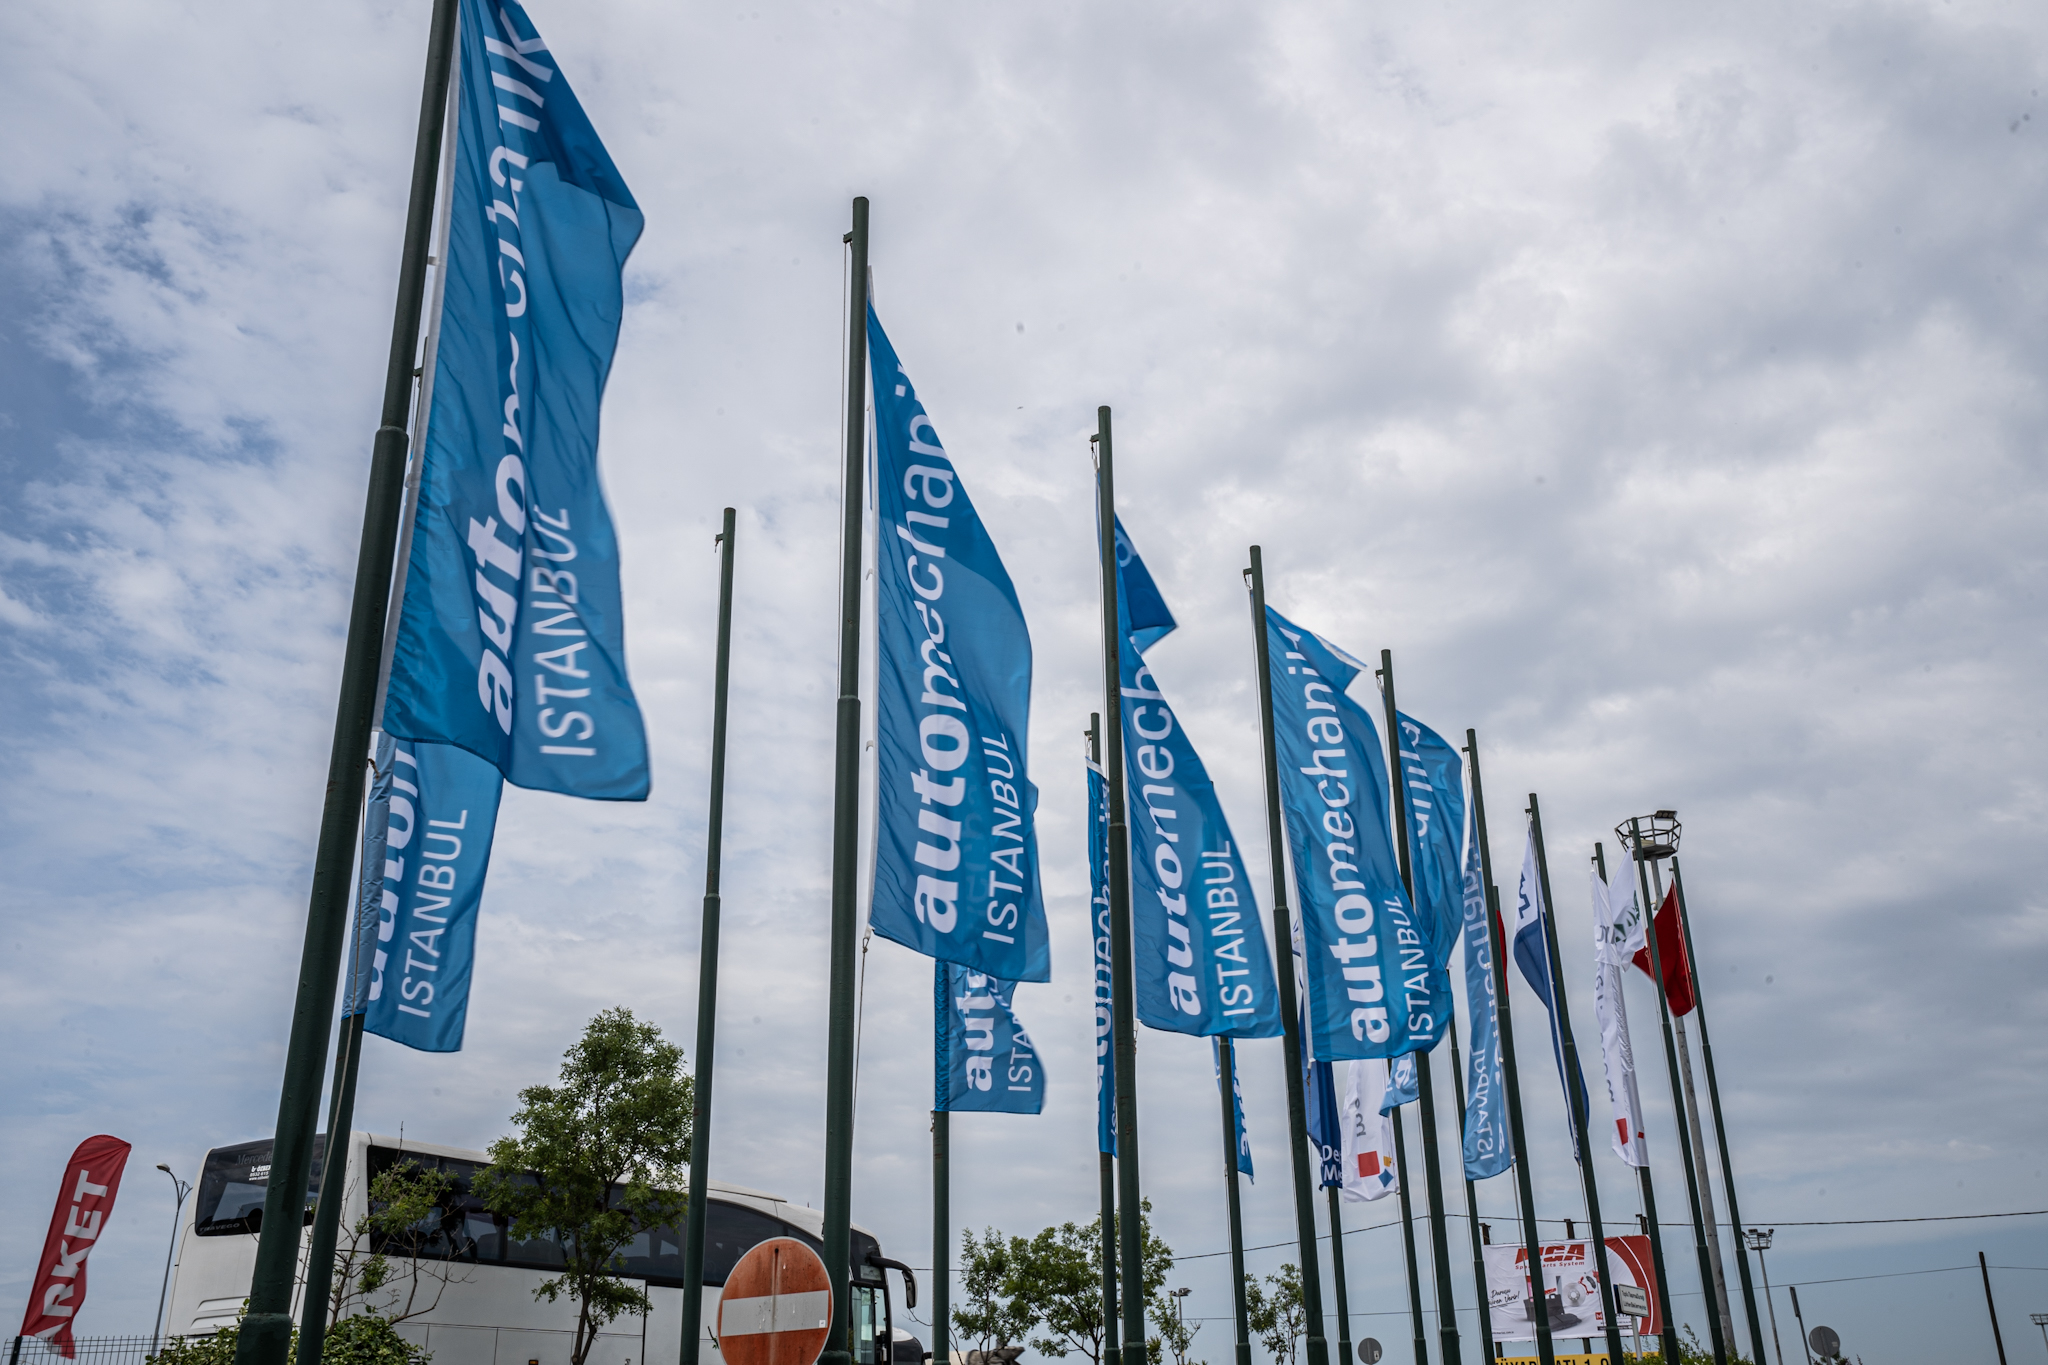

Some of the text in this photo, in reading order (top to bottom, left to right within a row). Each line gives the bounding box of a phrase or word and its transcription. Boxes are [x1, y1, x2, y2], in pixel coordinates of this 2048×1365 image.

[530, 504, 597, 756] ISTANBUL
[398, 809, 468, 1018] ISTANBUL
[981, 732, 1025, 944] ISTANBUL
[1201, 840, 1255, 1017] ISTANBUL
[1384, 896, 1434, 1041] ISTANBUL
